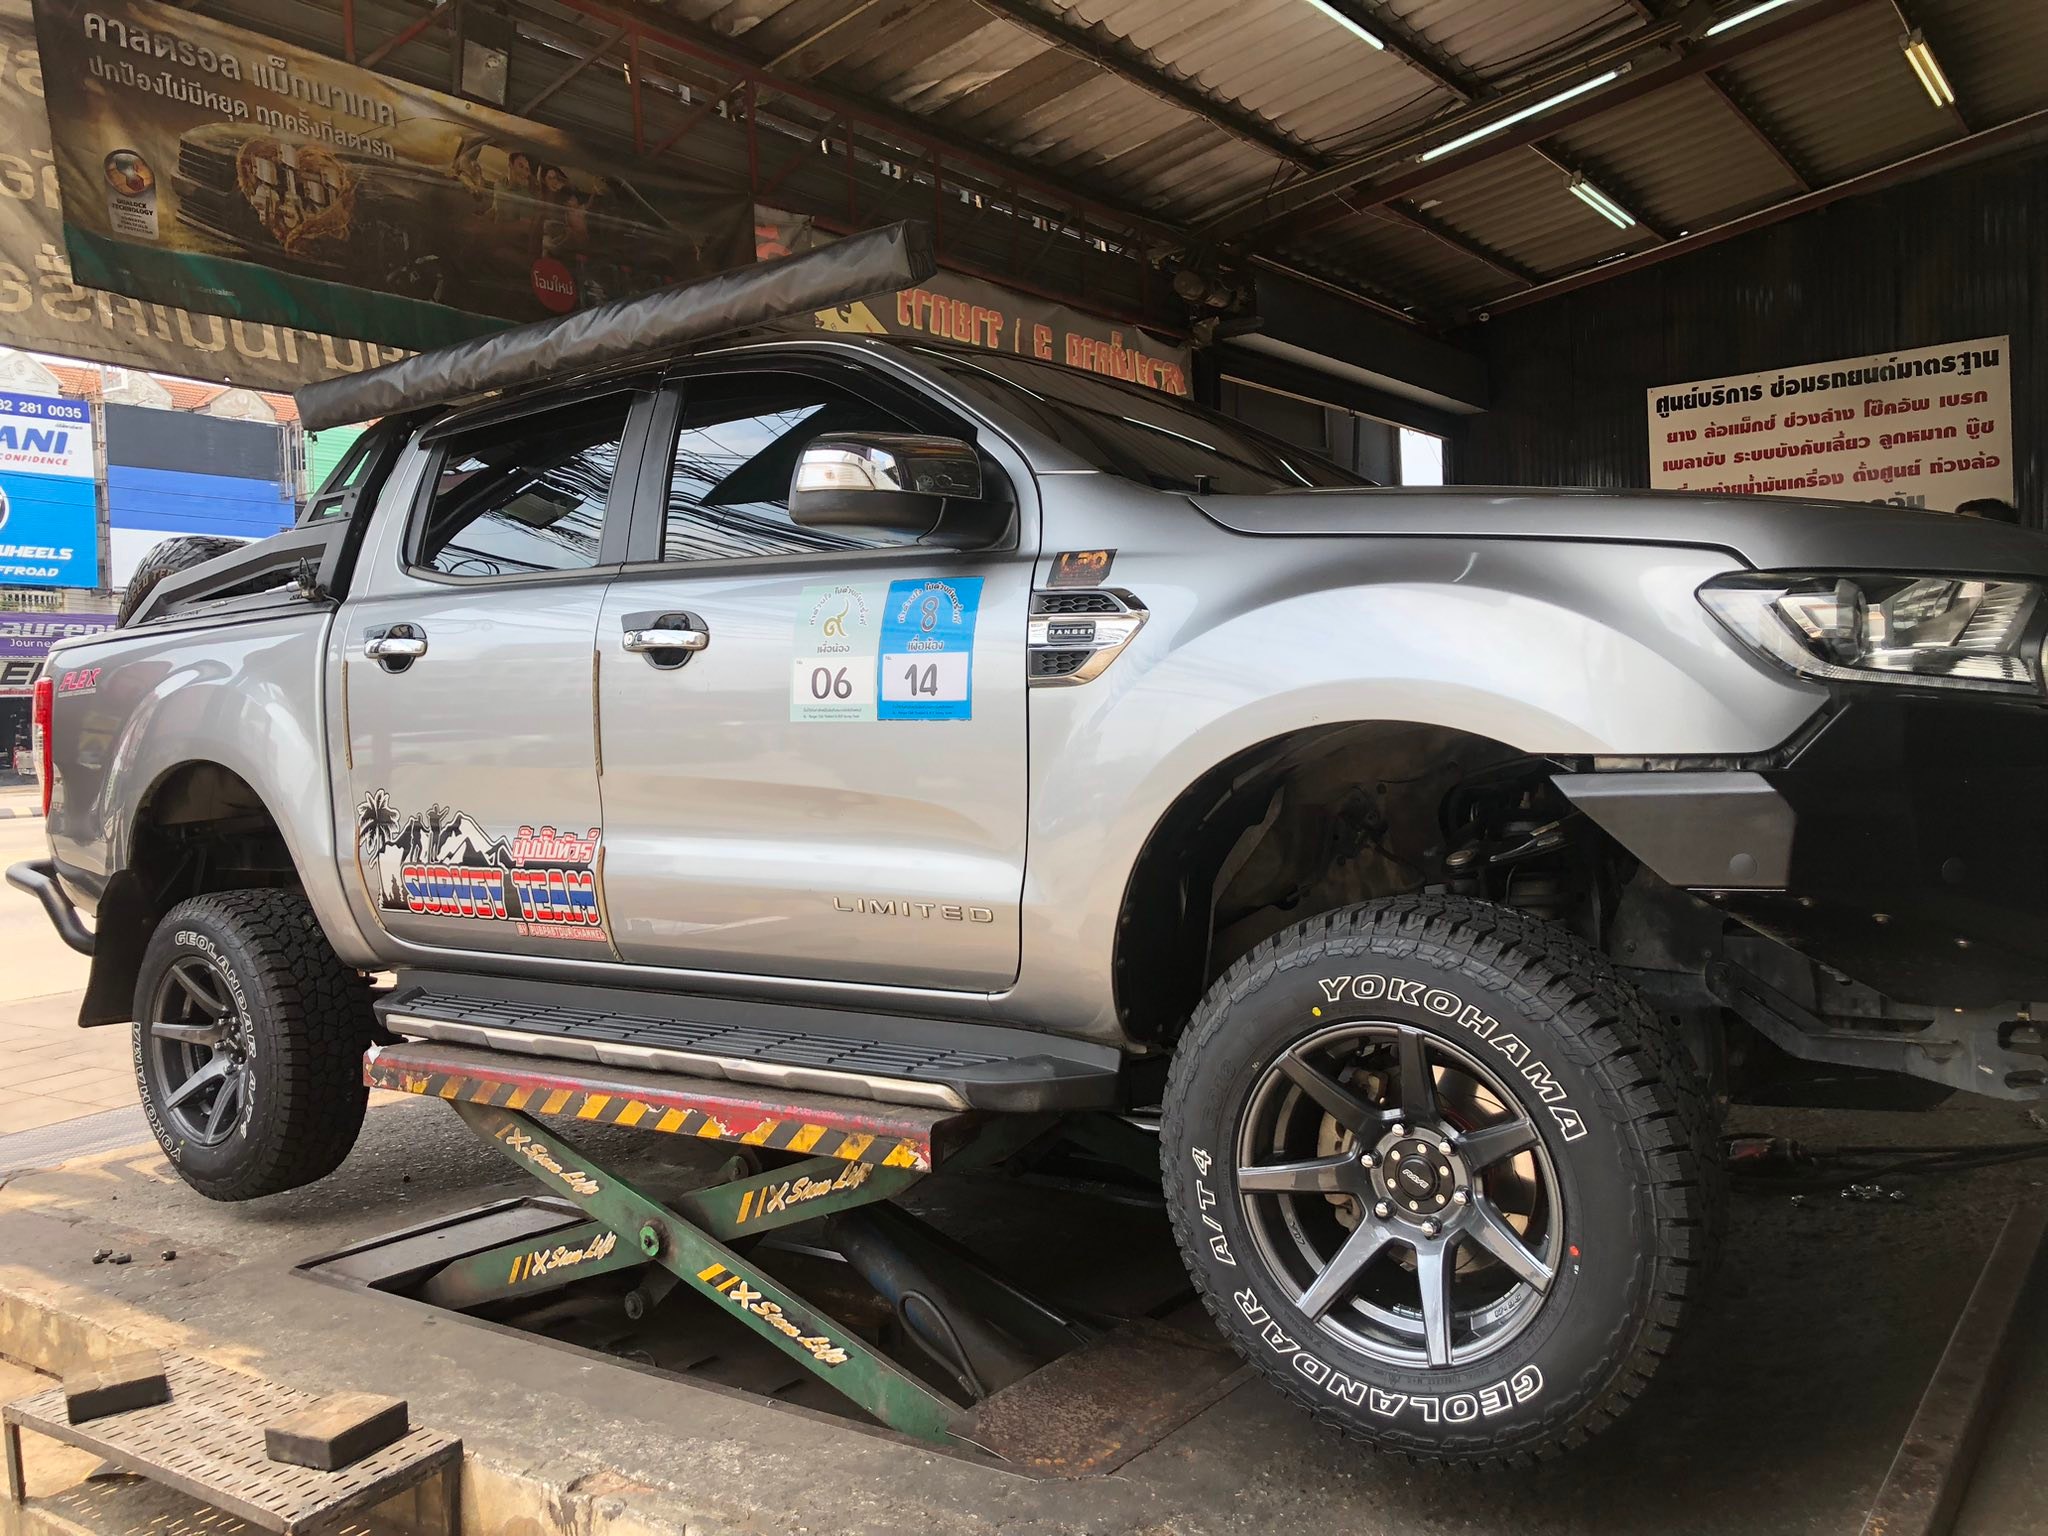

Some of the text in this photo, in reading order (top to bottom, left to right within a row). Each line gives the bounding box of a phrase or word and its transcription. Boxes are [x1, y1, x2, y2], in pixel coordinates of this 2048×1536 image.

[111, 202, 154, 216] TECHNOLOGY
[1656, 349, 2000, 418] ศูนย์บริการ ซ่อมรถยนต์มาตรฐาน
[19, 401, 42, 414] 281
[47, 405, 82, 418] 0035
[1666, 430, 1697, 444] ยาง
[1704, 414, 1777, 439] ล้อแม็กซ์
[1783, 408, 1855, 428] ช่วงล่าง
[1939, 390, 1988, 408] เบรก
[0, 453, 69, 466] ONFIDENCE
[1662, 452, 1726, 472] เพลาขับ
[1733, 430, 1871, 463] ระบบบังคับเลี้ยว
[1879, 425, 1957, 450] ลูกหมาก
[1852, 459, 1922, 484] ตั้งศูนย์
[1929, 450, 2001, 475] ถ่วงล้อ
[59, 668, 101, 691] FLEX
[811, 666, 852, 700] 06
[904, 663, 938, 697] 14
[402, 865, 601, 926] SURVEY TEAM
[832, 896, 995, 924] LIMITED
[174, 930, 258, 1060] GEOLANDAR
[1318, 973, 1591, 1144] YOKOHAMA
[132, 1021, 183, 1165] YOKOHAMA
[558, 1169, 602, 1196] Lift
[831, 1162, 874, 1191] Lift
[583, 1230, 619, 1261] Lift
[796, 1333, 848, 1365] Lift
[1233, 1287, 1544, 1423] GEOLANDAR
